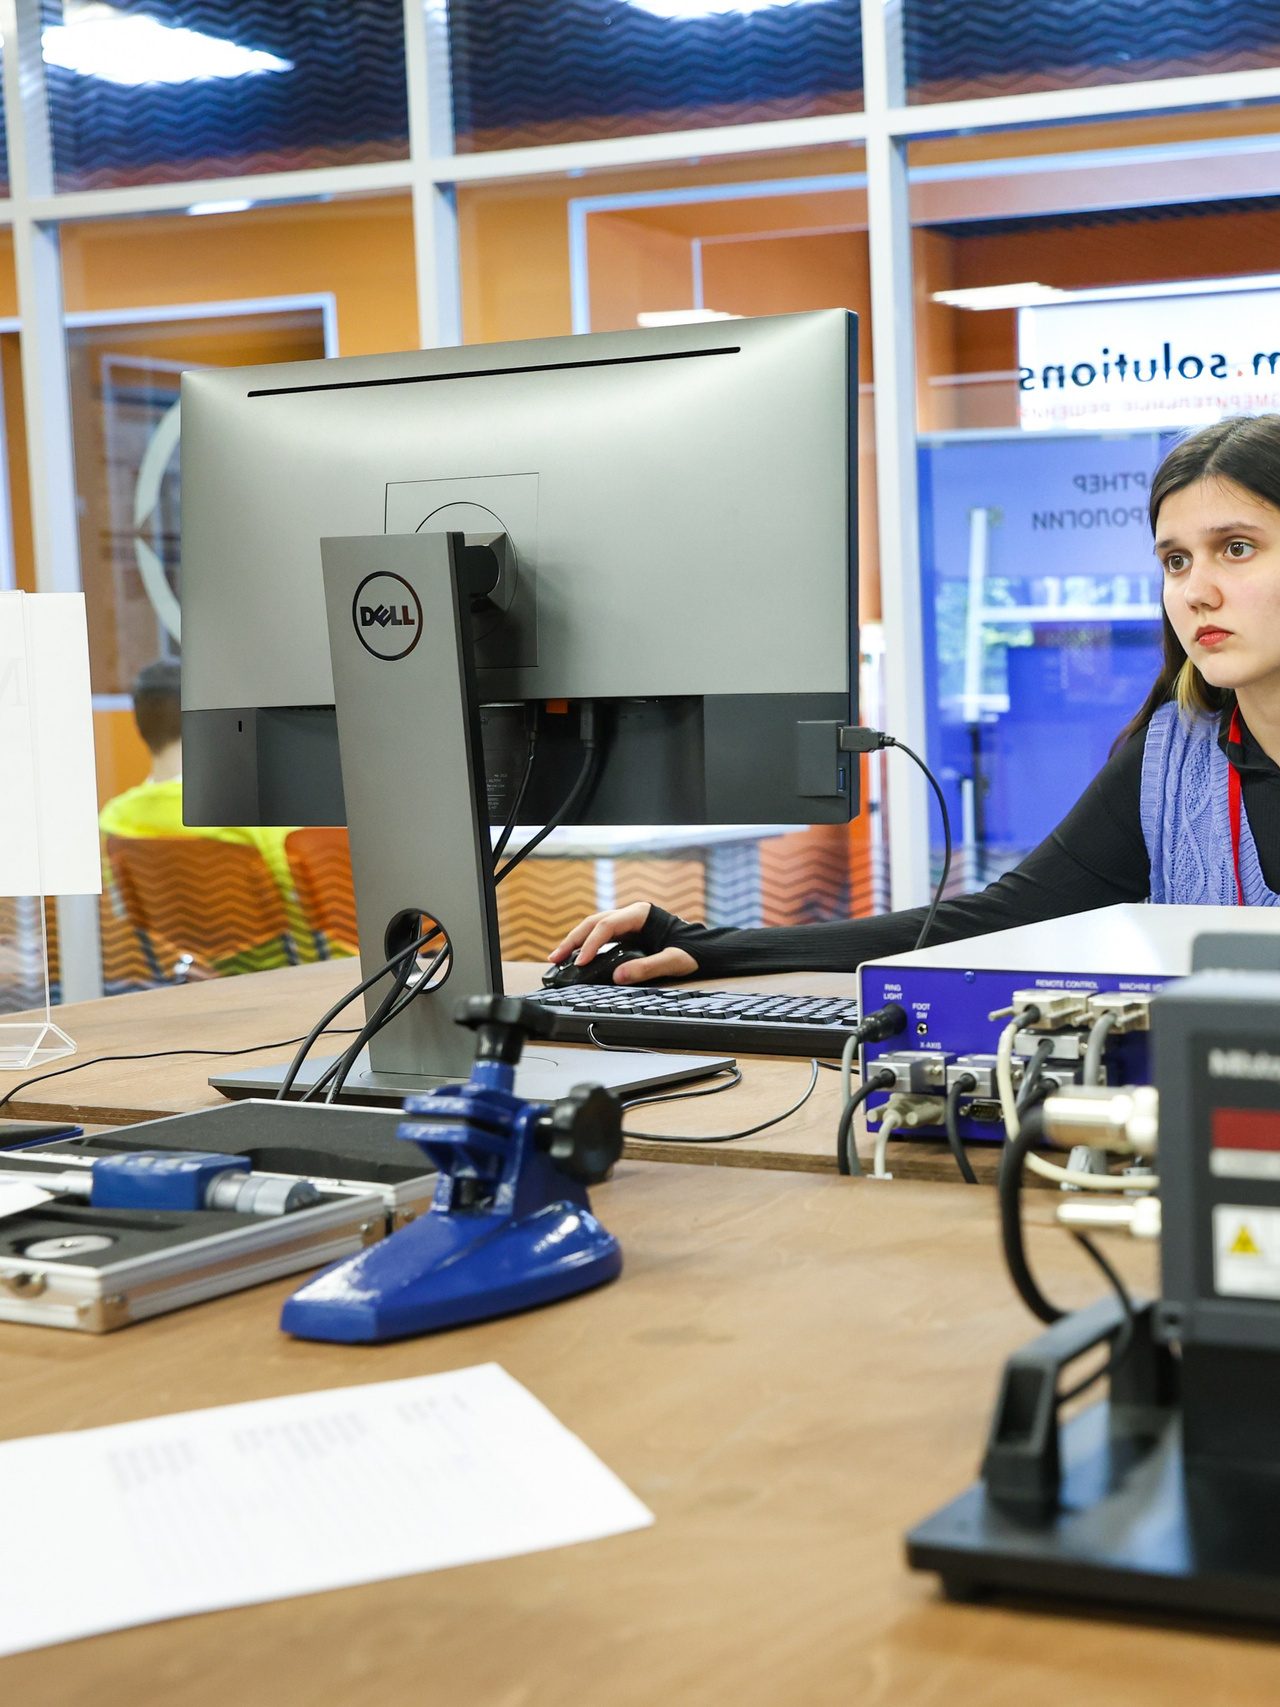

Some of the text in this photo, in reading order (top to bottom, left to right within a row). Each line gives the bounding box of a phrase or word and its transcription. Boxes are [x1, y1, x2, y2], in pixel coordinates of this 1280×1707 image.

[360, 604, 415, 628] DELL
[884, 984, 902, 992] RING
[1035, 979, 1099, 990] REMOTE CONTROL
[920, 1042, 942, 1050] X-AXIS
